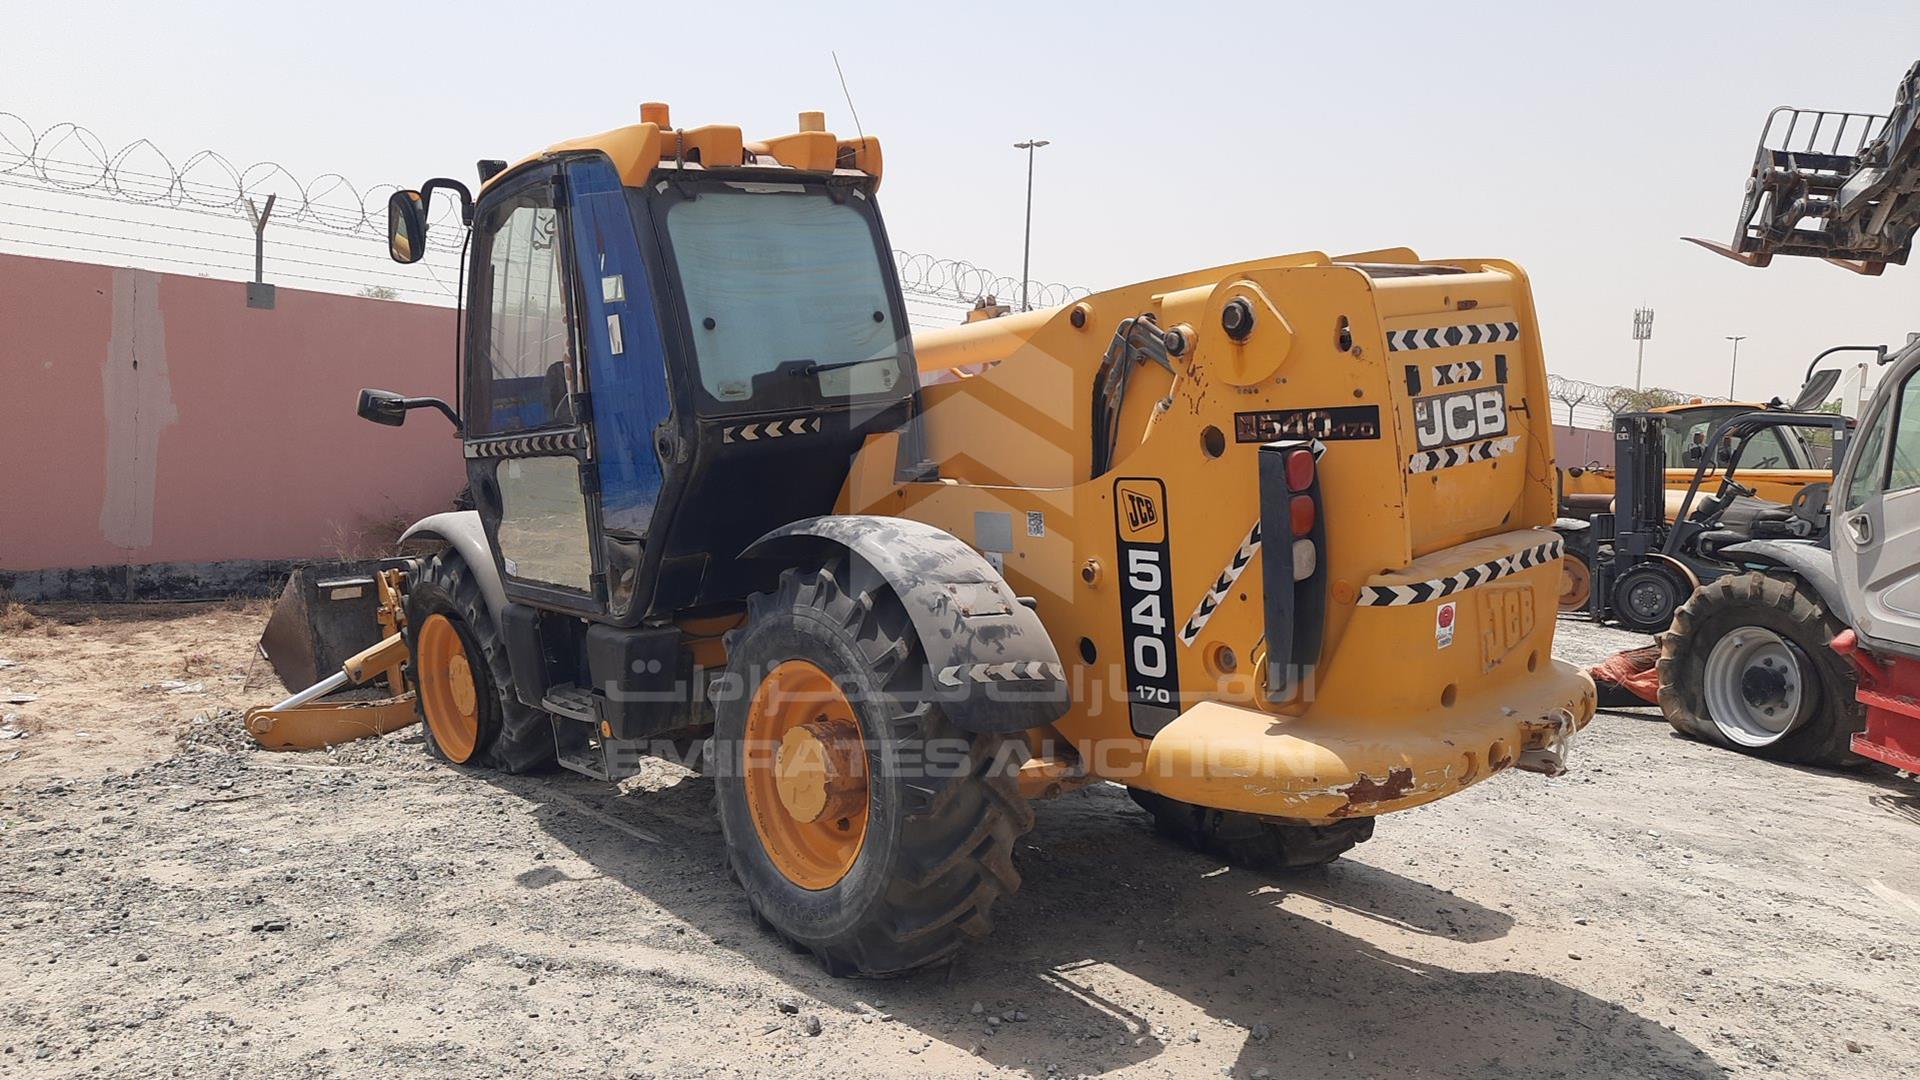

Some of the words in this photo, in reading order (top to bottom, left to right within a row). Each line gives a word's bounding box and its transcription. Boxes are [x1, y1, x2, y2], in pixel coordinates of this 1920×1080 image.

[1418, 391, 1506, 447] JCB
[1127, 494, 1155, 527] JCB
[1128, 549, 1167, 679] 540
[1484, 588, 1535, 668] JCB
[1136, 684, 1170, 704] 170
